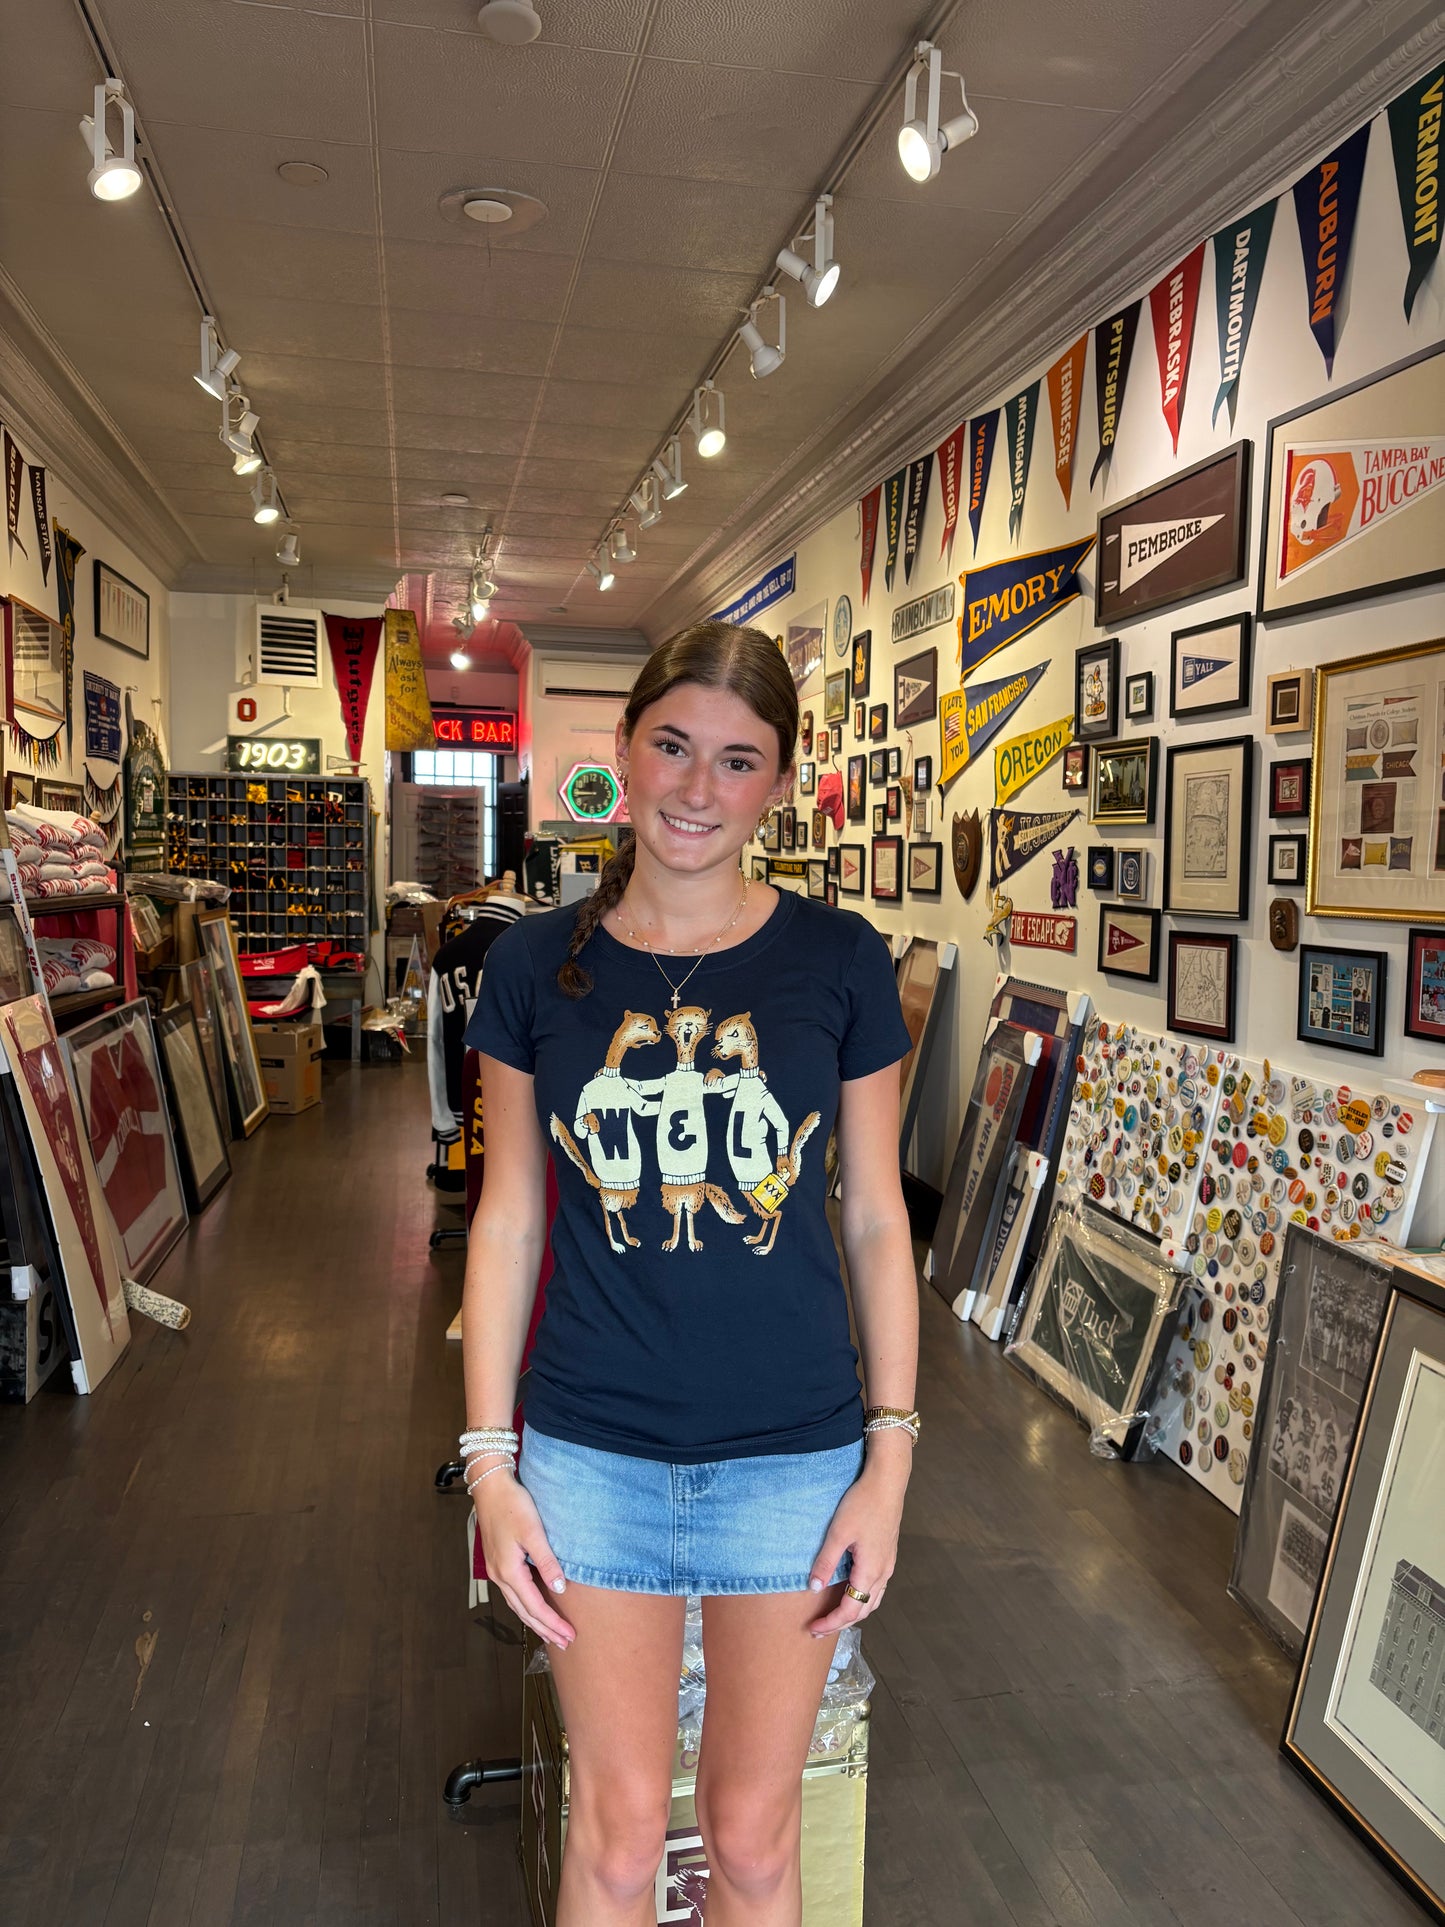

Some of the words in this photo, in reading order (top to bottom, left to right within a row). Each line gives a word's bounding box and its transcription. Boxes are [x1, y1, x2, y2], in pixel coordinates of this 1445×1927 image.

[1414, 75, 1445, 247] VERMONT
[1310, 161, 1339, 325] AUBURN
[1223, 228, 1251, 383] DARTMOUTH
[1164, 271, 1184, 407] NEBRASKA
[1101, 318, 1124, 447] PITTSBURG
[1057, 357, 1074, 470] TENNESSEE
[1013, 396, 1028, 486] MICHIGAN
[1363, 448, 1408, 475] TAMPA
[1410, 446, 1430, 463] BAY
[9, 445, 17, 534] BRADLEY
[913, 461, 924, 506] PENN
[946, 440, 956, 529] STANFORD
[969, 422, 986, 512] VIRGINIA
[35, 471, 45, 519] KANSAS
[40, 522, 51, 558] STATE
[890, 480, 898, 545] MIAMI
[906, 508, 918, 554] STATE
[1127, 519, 1203, 568] PEMBROKE
[895, 596, 934, 639] RAINBOW
[935, 590, 948, 621] LA
[967, 564, 1065, 643] EMORY
[388, 655, 423, 674] Always
[400, 673, 418, 682] ask
[1195, 662, 1214, 675] YALE
[237, 698, 257, 721] O
[400, 683, 417, 697] for
[947, 695, 963, 712] LOVE
[967, 701, 988, 737] SAN
[987, 675, 1029, 720] FRANCISCO
[238, 742, 305, 769] 1903
[472, 720, 512, 743] BAR
[950, 740, 964, 761] YOU
[590, 774, 597, 782] 12
[1000, 730, 1062, 787] OREGON
[1386, 761, 1410, 769] CHICAGO
[1010, 915, 1026, 940] FIRE
[1027, 917, 1055, 944] ESCAPE
[1294, 1080, 1306, 1092] UB
[589, 1108, 630, 1160] W
[668, 1109, 697, 1152] &
[733, 1110, 752, 1159] L
[977, 1117, 993, 1164] NEW
[764, 1181, 783, 1201] XXX
[961, 1169, 979, 1216] YORK
[1386, 1166, 1404, 1179] WYOMING
[992, 1220, 1010, 1271] DUKE
[1080, 1293, 1119, 1348] Tuck
